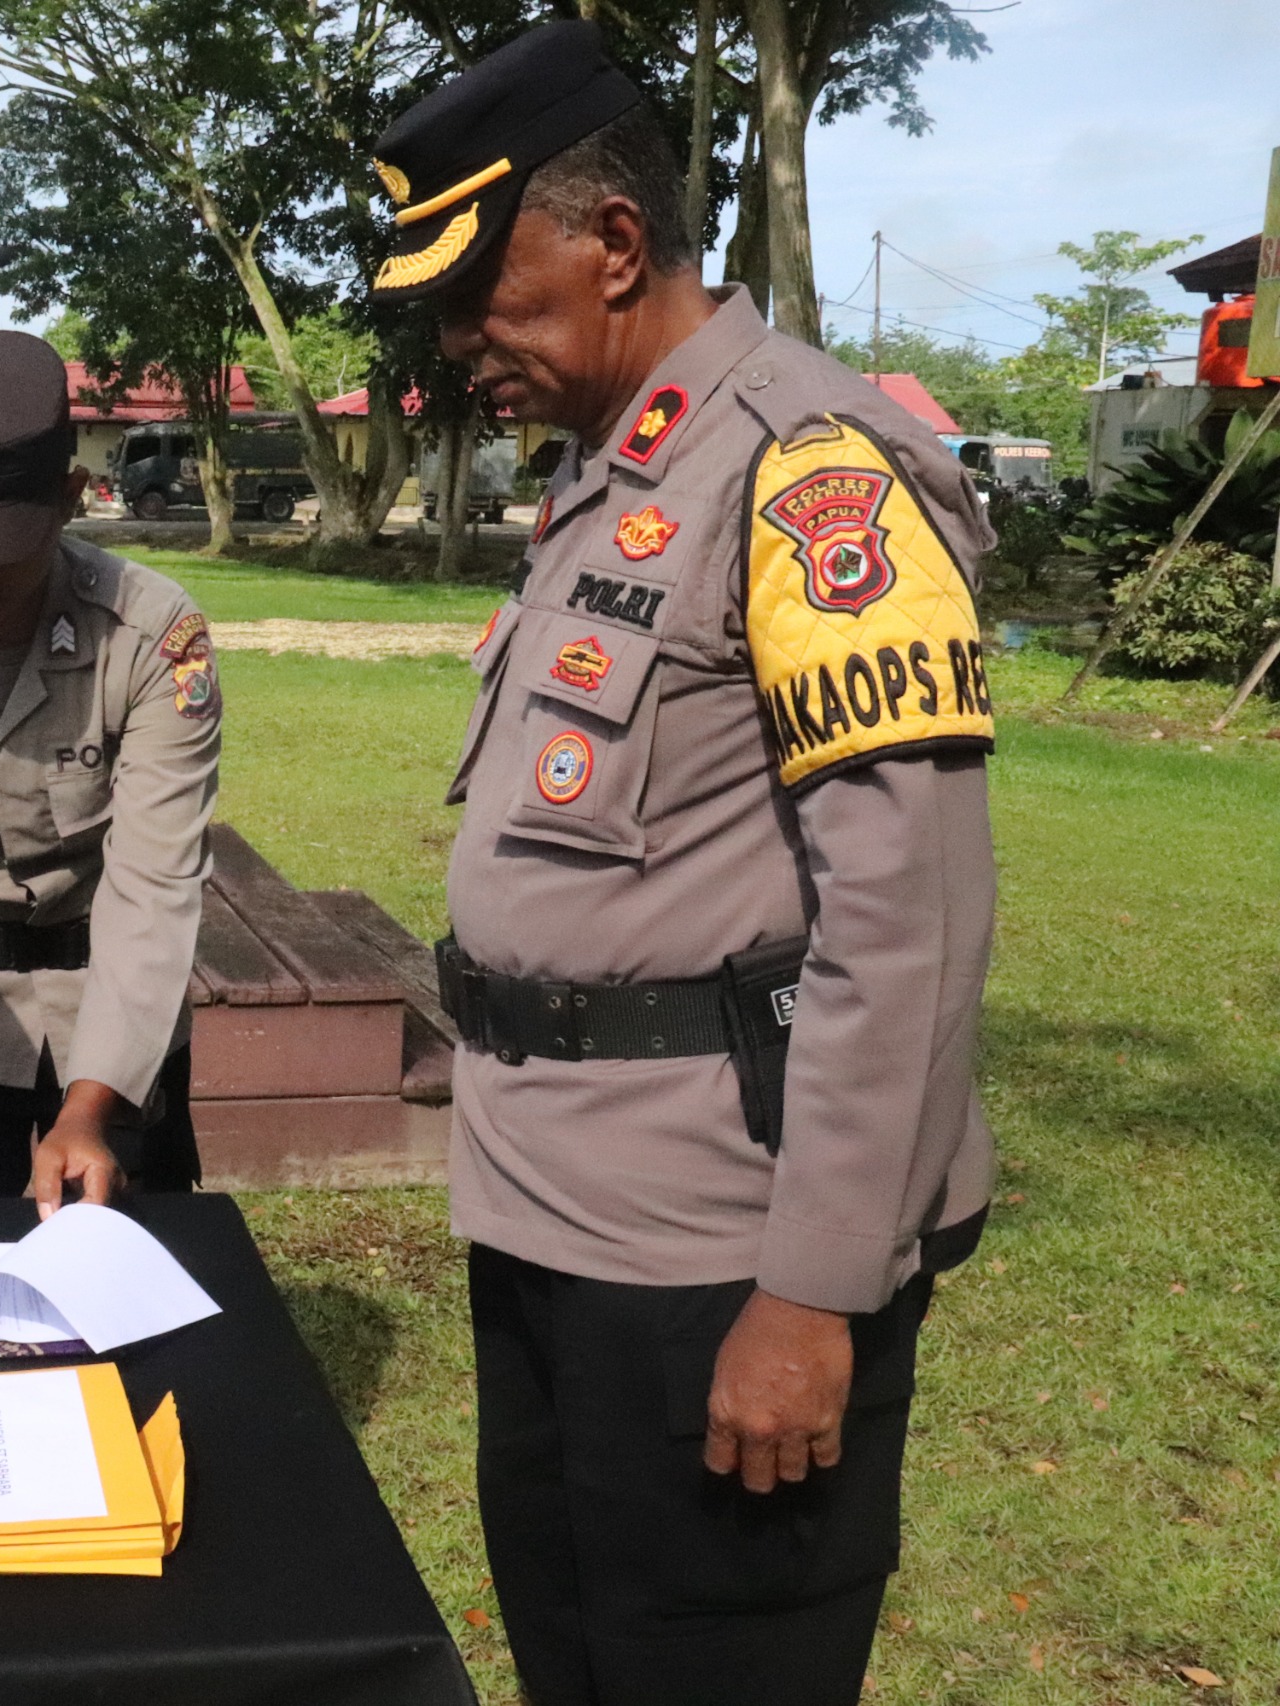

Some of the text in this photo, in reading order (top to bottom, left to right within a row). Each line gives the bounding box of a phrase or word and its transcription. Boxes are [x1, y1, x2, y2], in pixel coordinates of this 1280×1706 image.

[994, 446, 1051, 458] POLRES KEERO
[785, 478, 870, 513] POLRES
[792, 487, 866, 516] KEEROM
[806, 507, 861, 531] PAPUA
[567, 571, 665, 630] POLRI
[165, 614, 203, 652] POLRES
[766, 641, 938, 766] AKAOPS
